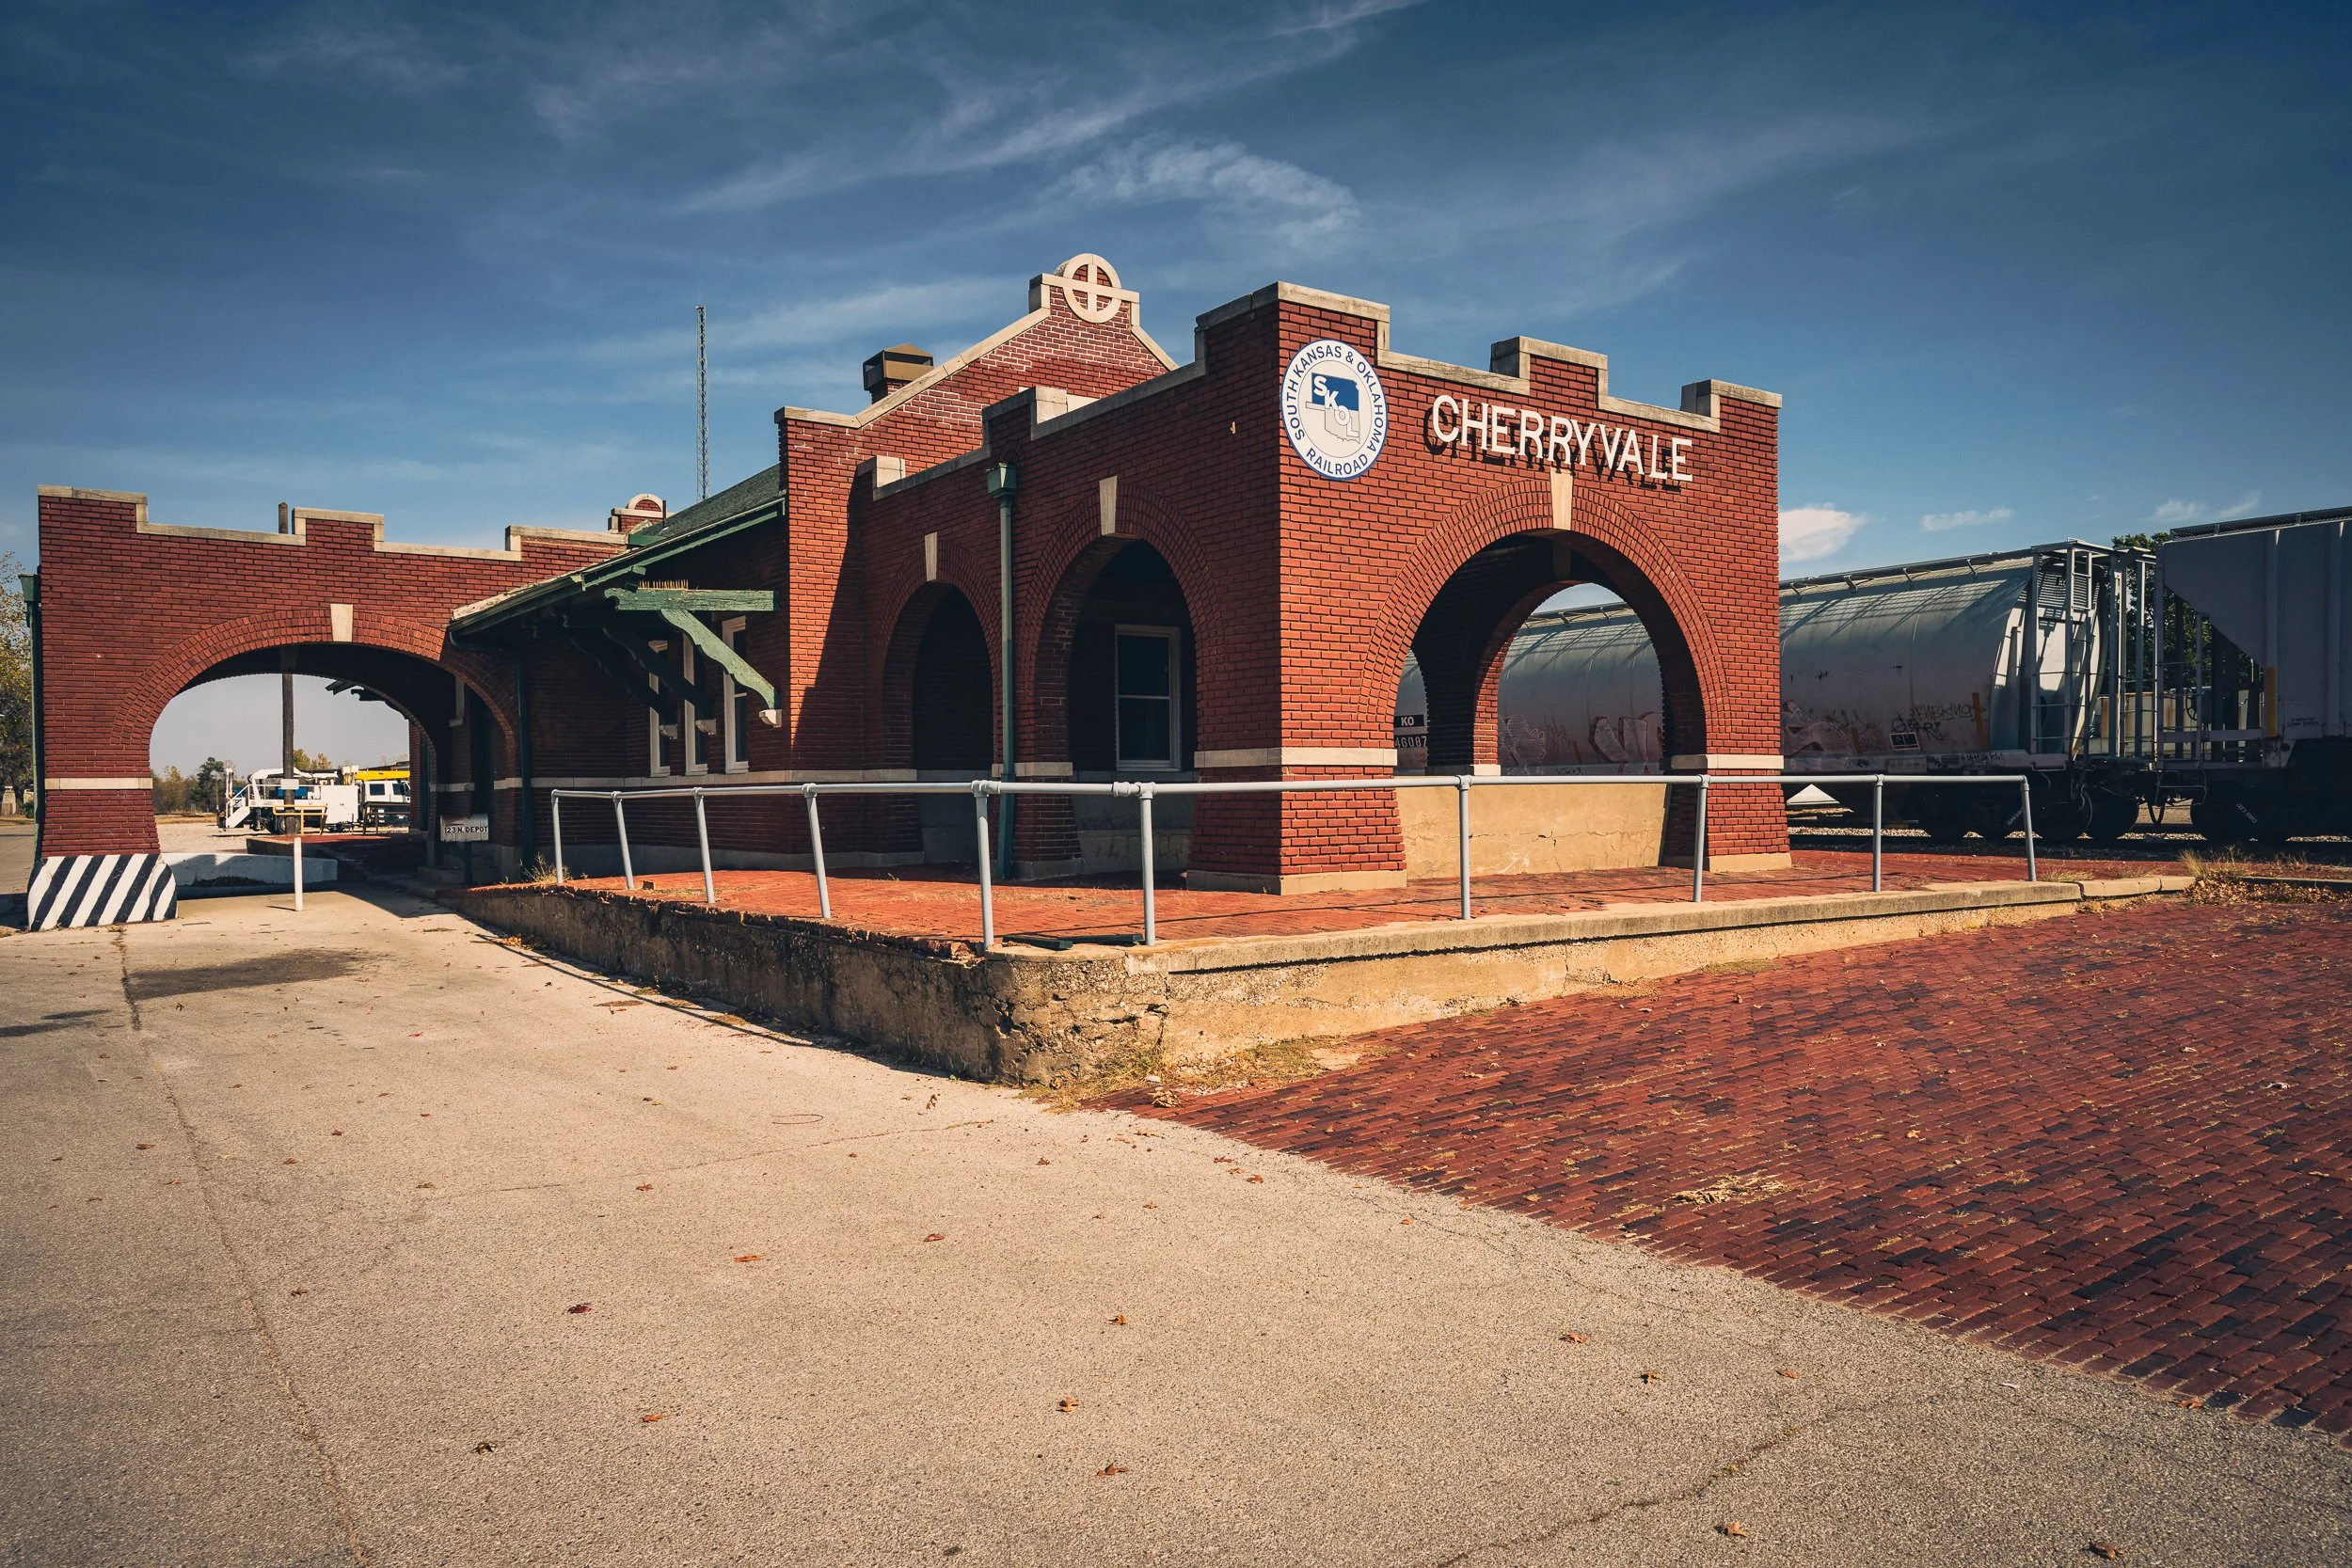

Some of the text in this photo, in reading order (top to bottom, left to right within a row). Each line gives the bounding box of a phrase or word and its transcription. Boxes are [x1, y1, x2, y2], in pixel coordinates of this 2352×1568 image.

[1286, 344, 1384, 453] SOUTH KANSAS & OKLAHOMA
[1306, 447, 1369, 476] RAILROAD
[1432, 394, 1693, 482] CHERRYVALE
[1401, 717, 1415, 726] KO
